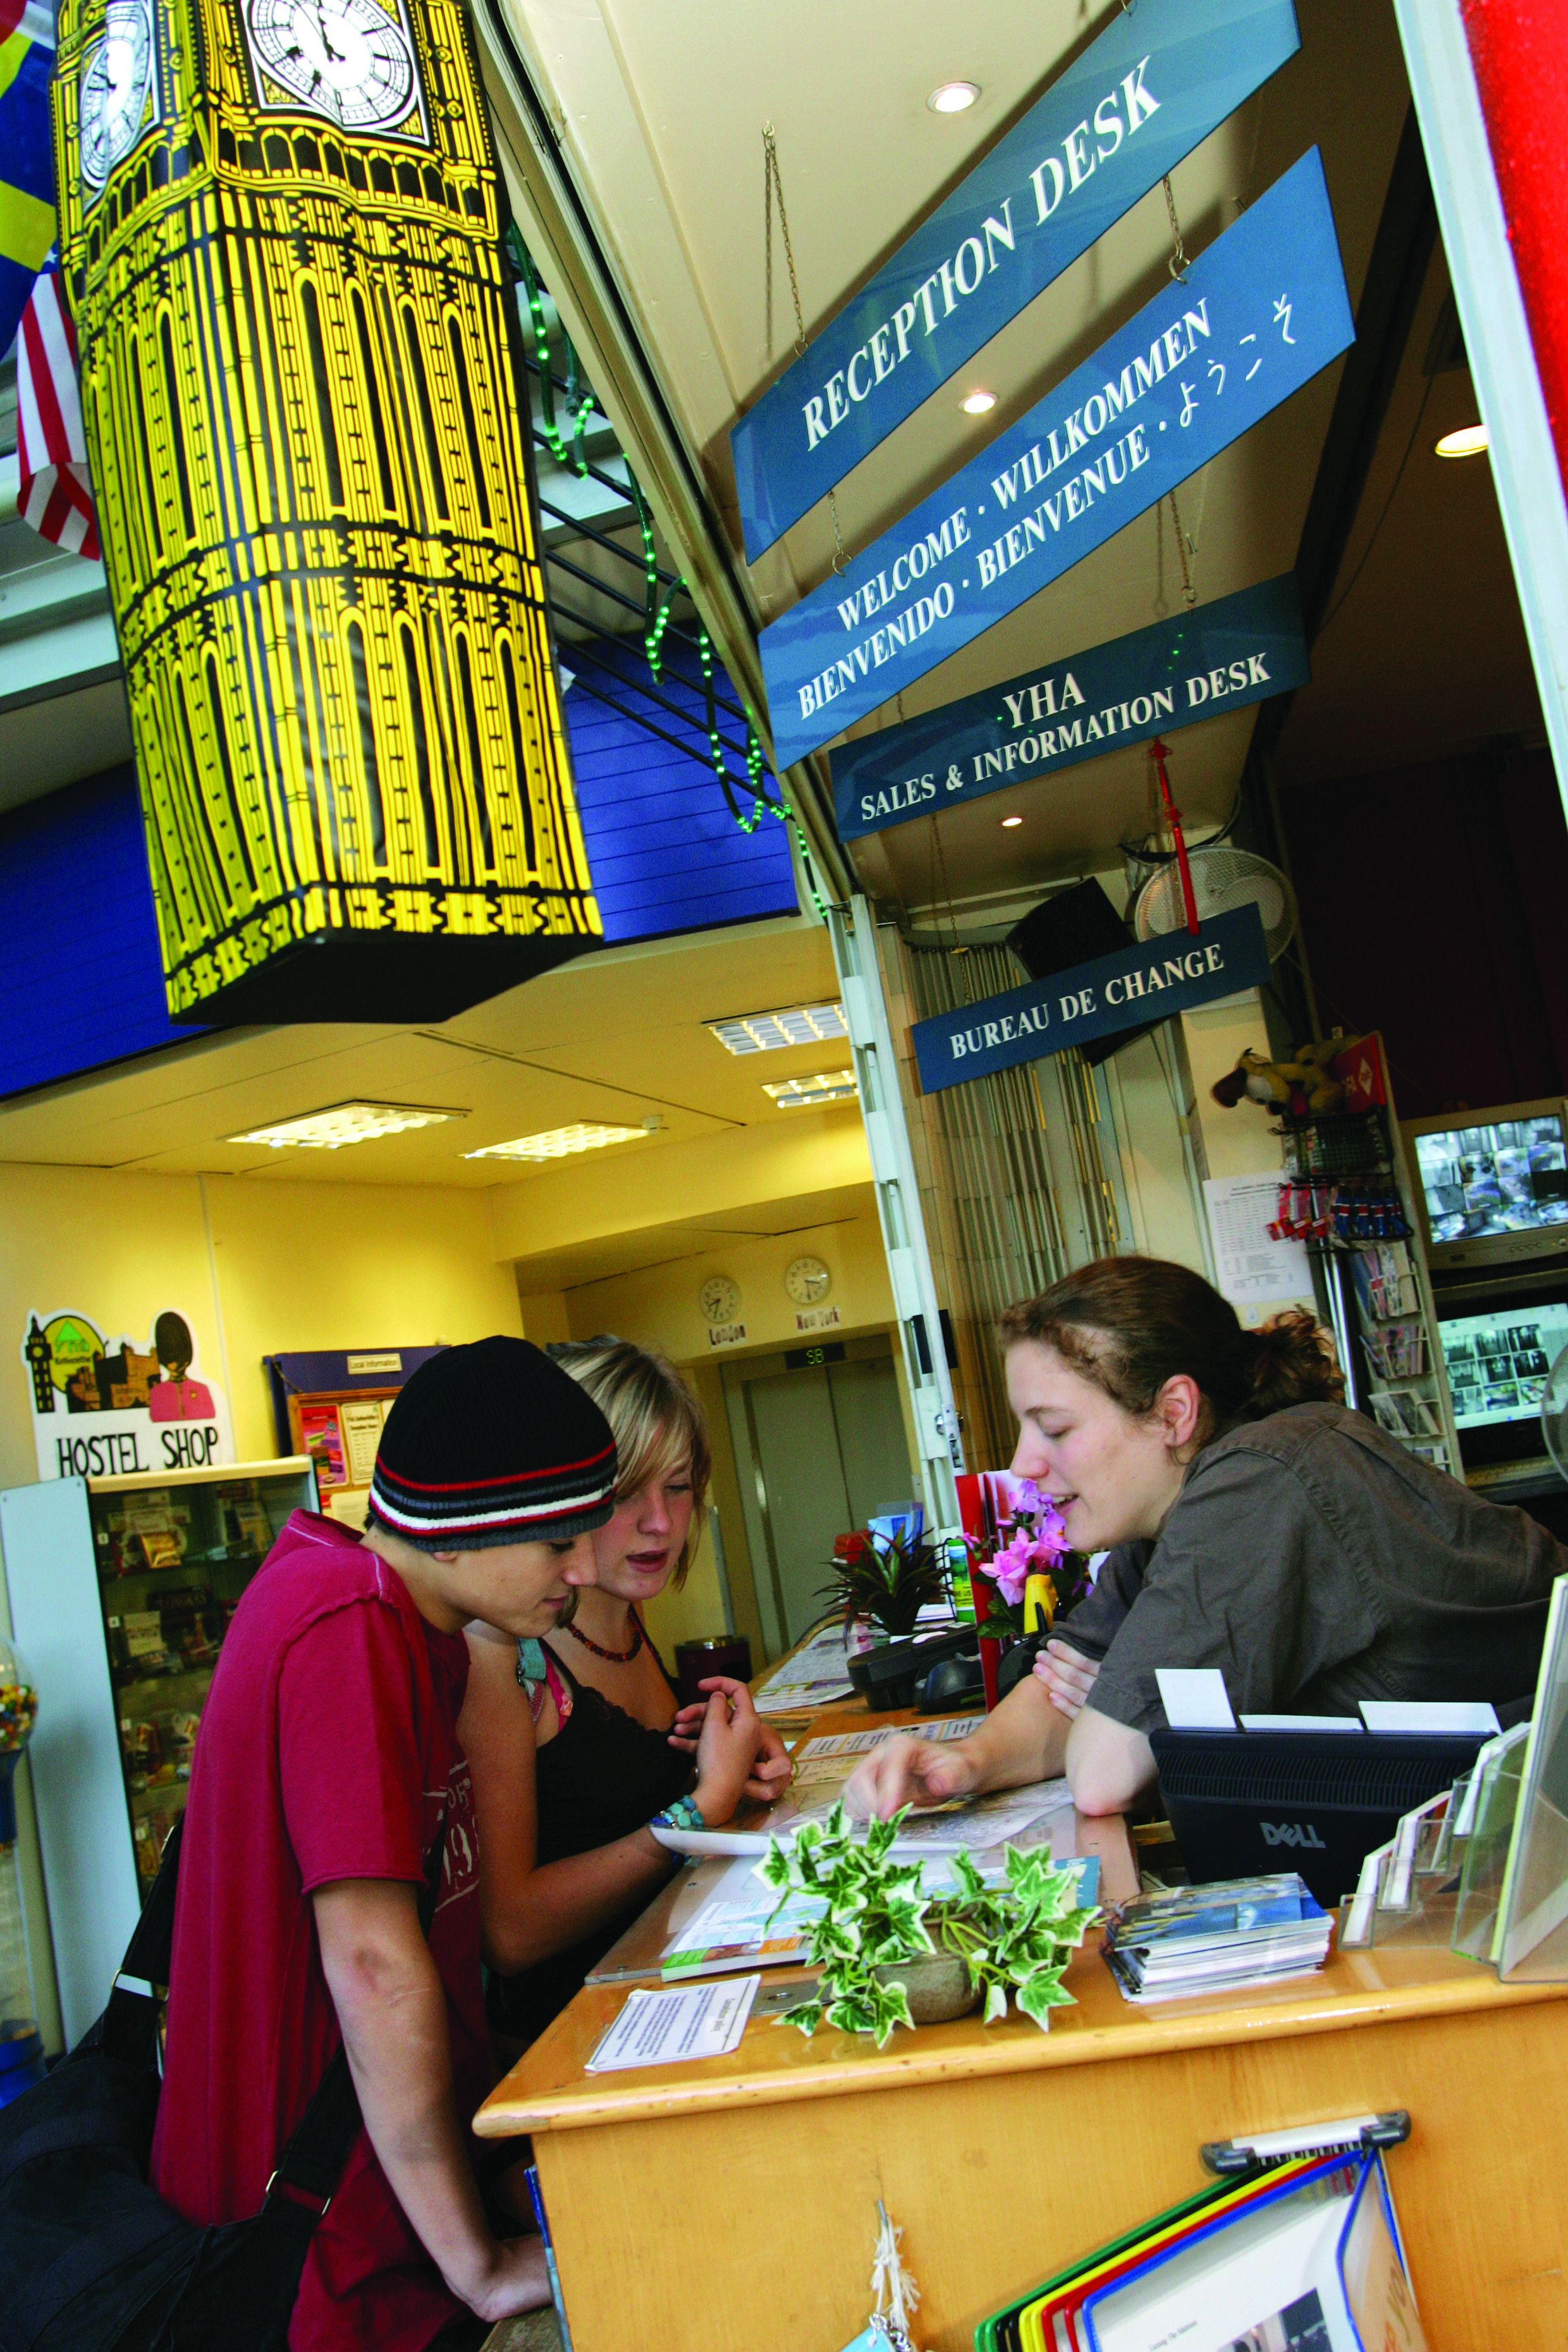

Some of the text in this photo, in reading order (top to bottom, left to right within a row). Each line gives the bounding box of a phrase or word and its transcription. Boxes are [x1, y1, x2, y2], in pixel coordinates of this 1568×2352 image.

[802, 55, 1161, 451] RECEPTION DESK
[837, 298, 1210, 630] WELCOME WILLKOMMEN
[798, 424, 1149, 720] BIENVENIDO BIENVENUE
[861, 653, 1271, 820] SALES & INFORMATION DESK
[1003, 673, 1086, 728] YHA
[950, 944, 1223, 1058] BUREAU DE CHANGE
[56, 1426, 219, 1478] HOSTEL SHOP
[1260, 1823, 1325, 1848] DELL
